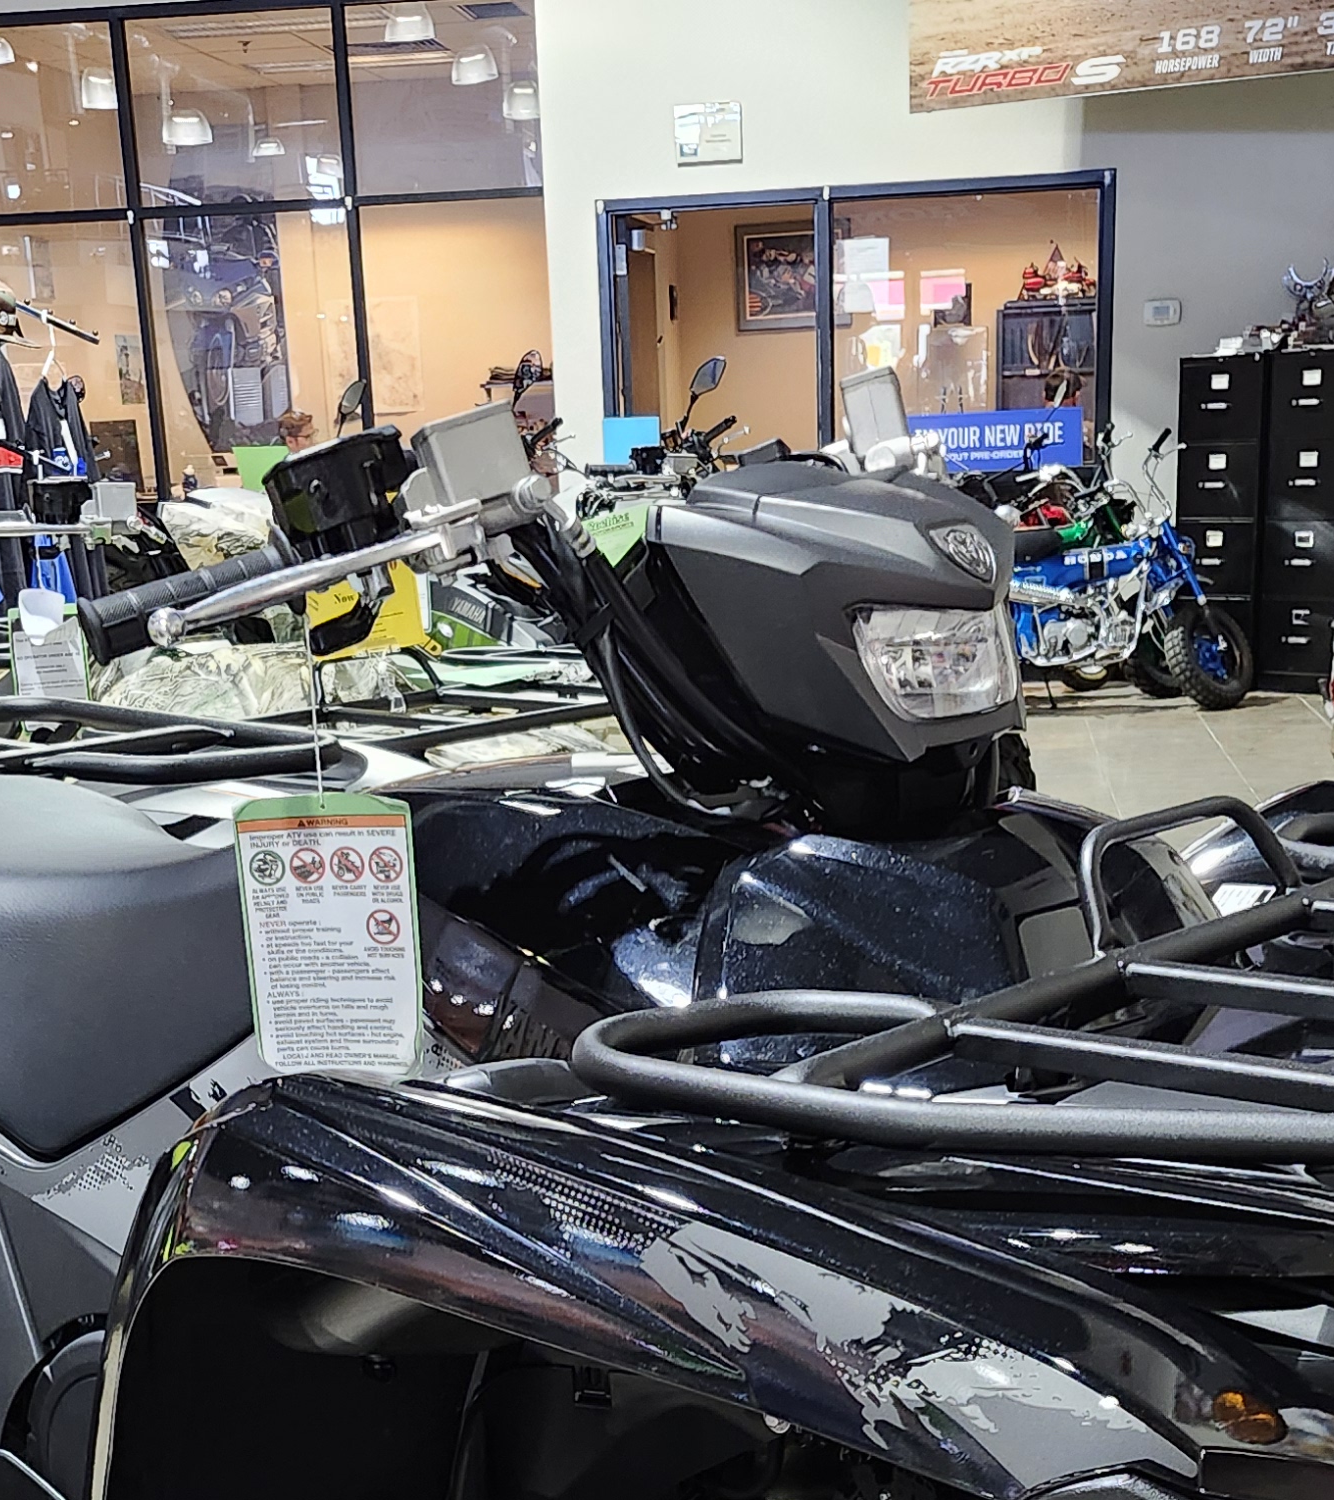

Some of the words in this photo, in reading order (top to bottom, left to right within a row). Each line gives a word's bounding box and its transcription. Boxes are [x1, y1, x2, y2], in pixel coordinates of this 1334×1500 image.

[1157, 25, 1221, 53] 168
[1244, 15, 1300, 43] 72"
[931, 51, 1003, 77] RZR
[1154, 54, 1219, 75] HORSEPOWER
[1249, 46, 1283, 64] WIDTH
[924, 62, 1074, 99] TURBO
[1070, 54, 1127, 86] S
[938, 426, 980, 449] YOUR
[984, 424, 1021, 447] NEW
[450, 596, 487, 626] YAMAHA
[306, 818, 348, 827] WARNING
